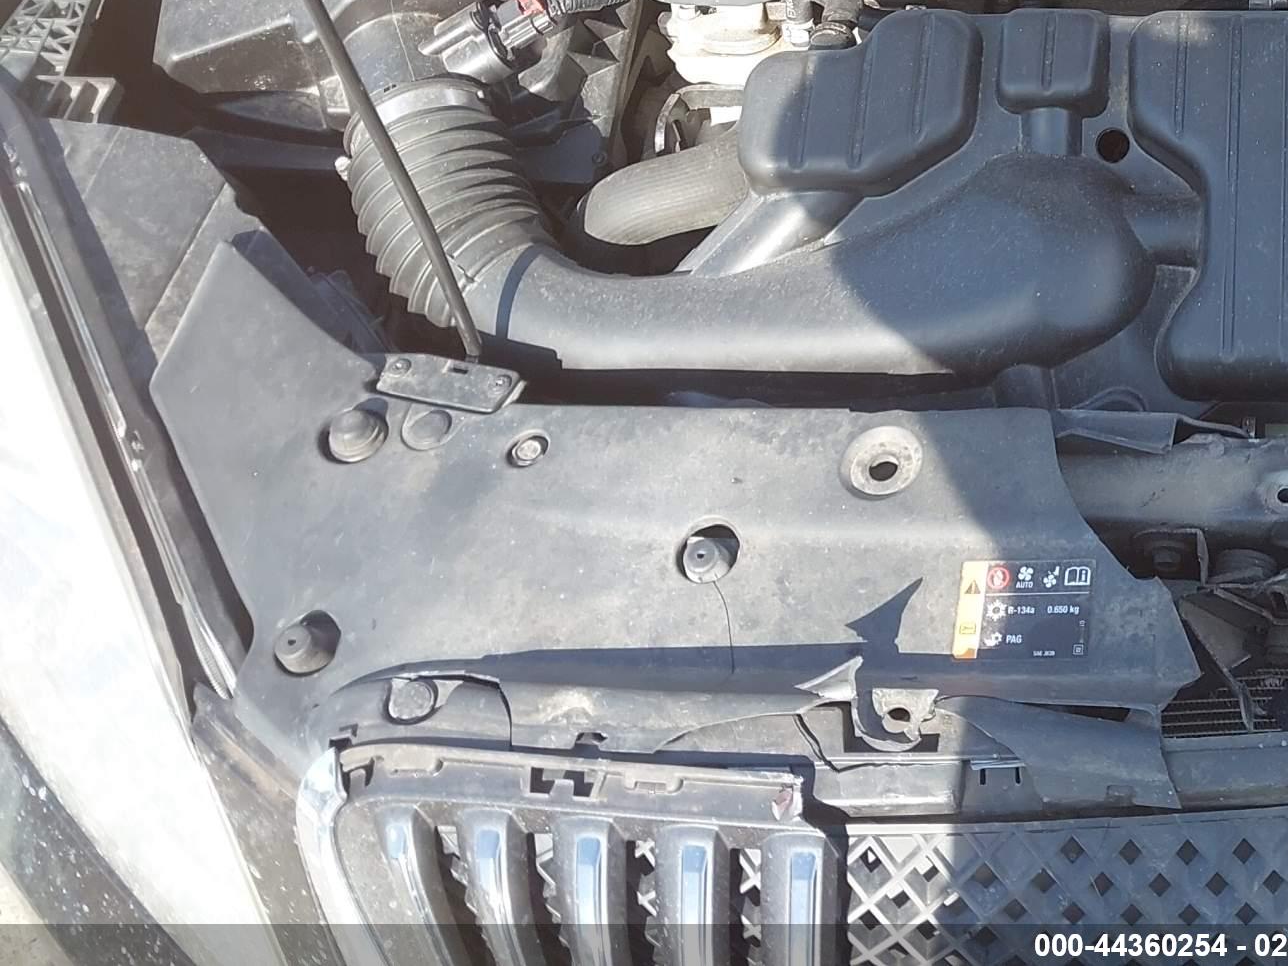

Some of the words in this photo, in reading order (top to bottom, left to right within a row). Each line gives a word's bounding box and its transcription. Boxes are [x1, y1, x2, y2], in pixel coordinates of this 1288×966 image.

[1015, 581, 1034, 589] AUTO
[1007, 605, 1035, 615] R-134a
[1047, 605, 1068, 614] 0.650
[1069, 605, 1080, 615] kg
[1005, 634, 1023, 644] PAG
